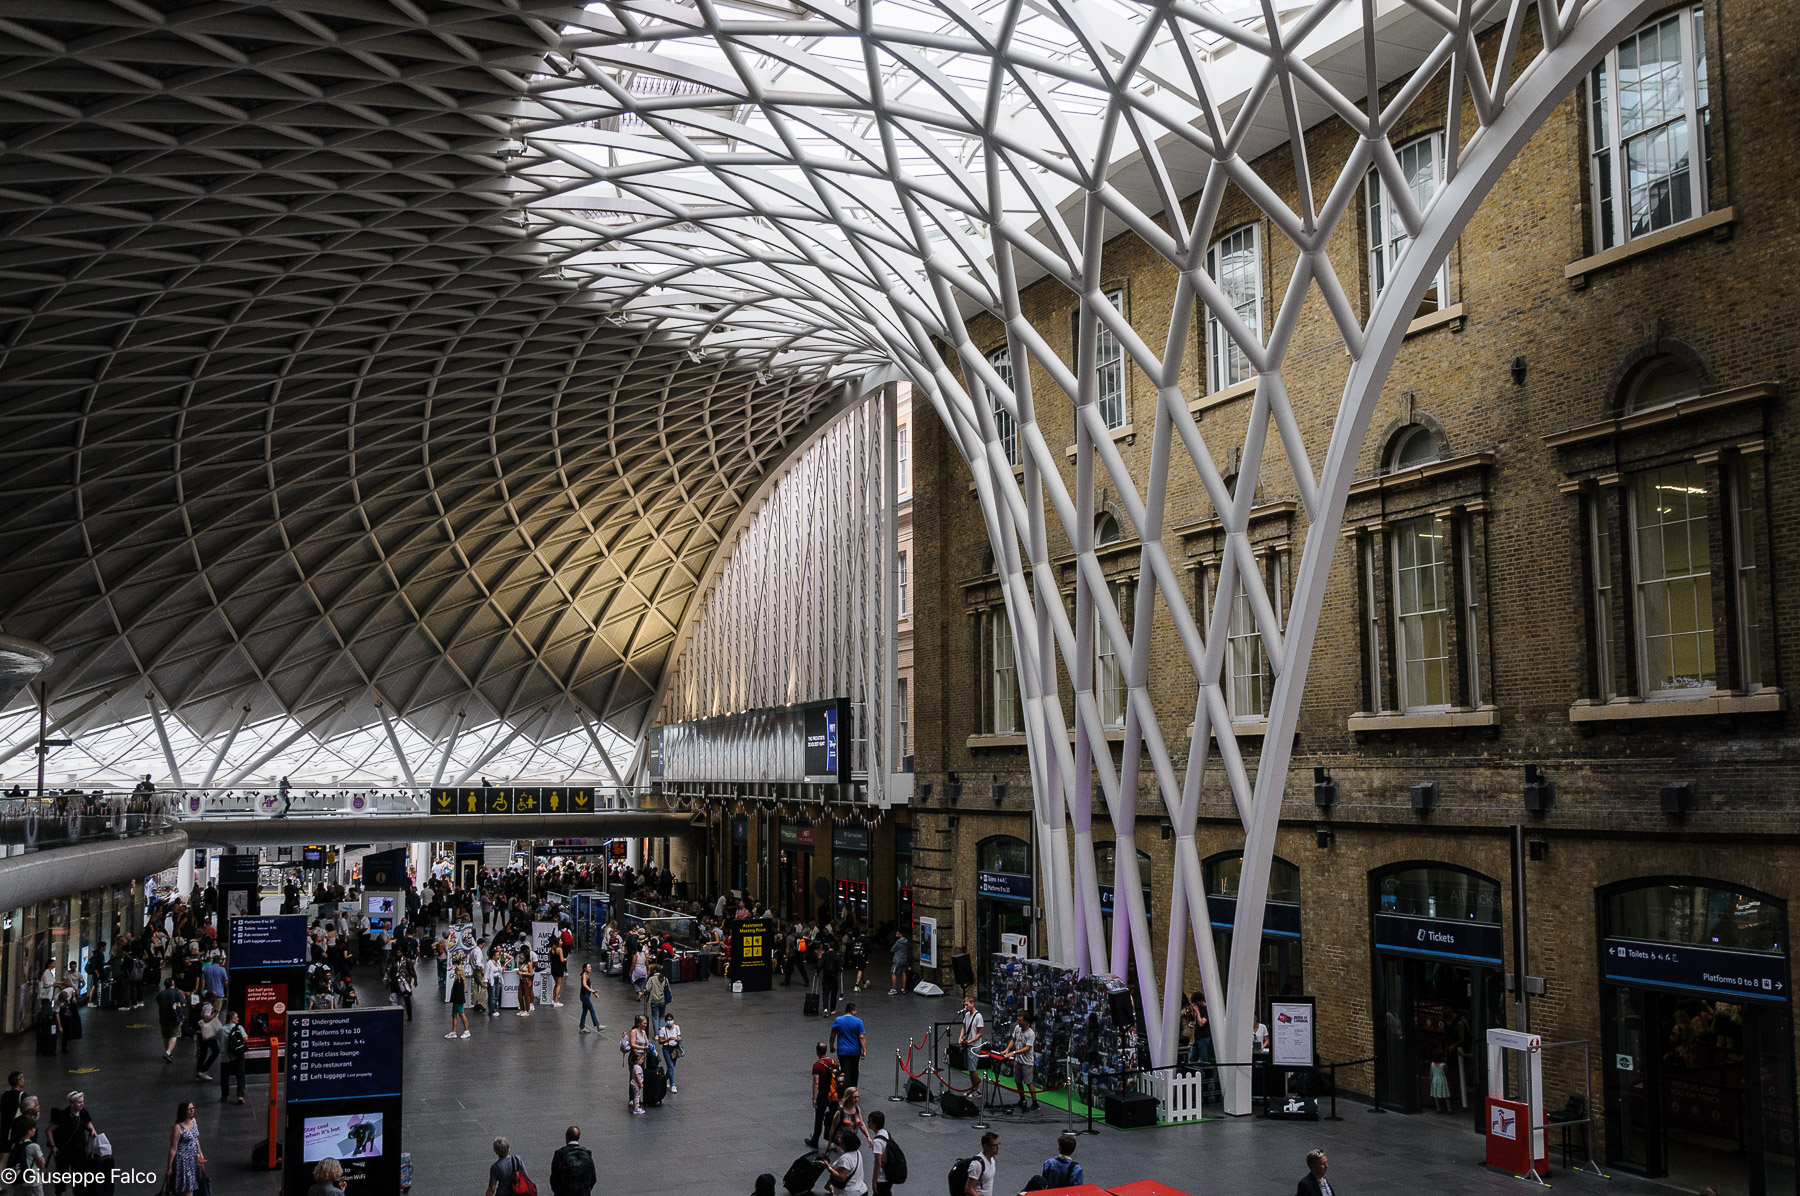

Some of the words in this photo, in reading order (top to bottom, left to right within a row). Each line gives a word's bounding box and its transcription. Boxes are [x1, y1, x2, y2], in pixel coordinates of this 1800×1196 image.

[1428, 931, 1454, 943] Tickets
[1628, 949, 1649, 959] Toilets
[1703, 973, 1736, 985] Platforms
[1670, 1088, 1684, 1098] YOU
[1697, 1093, 1720, 1104] TRACK
